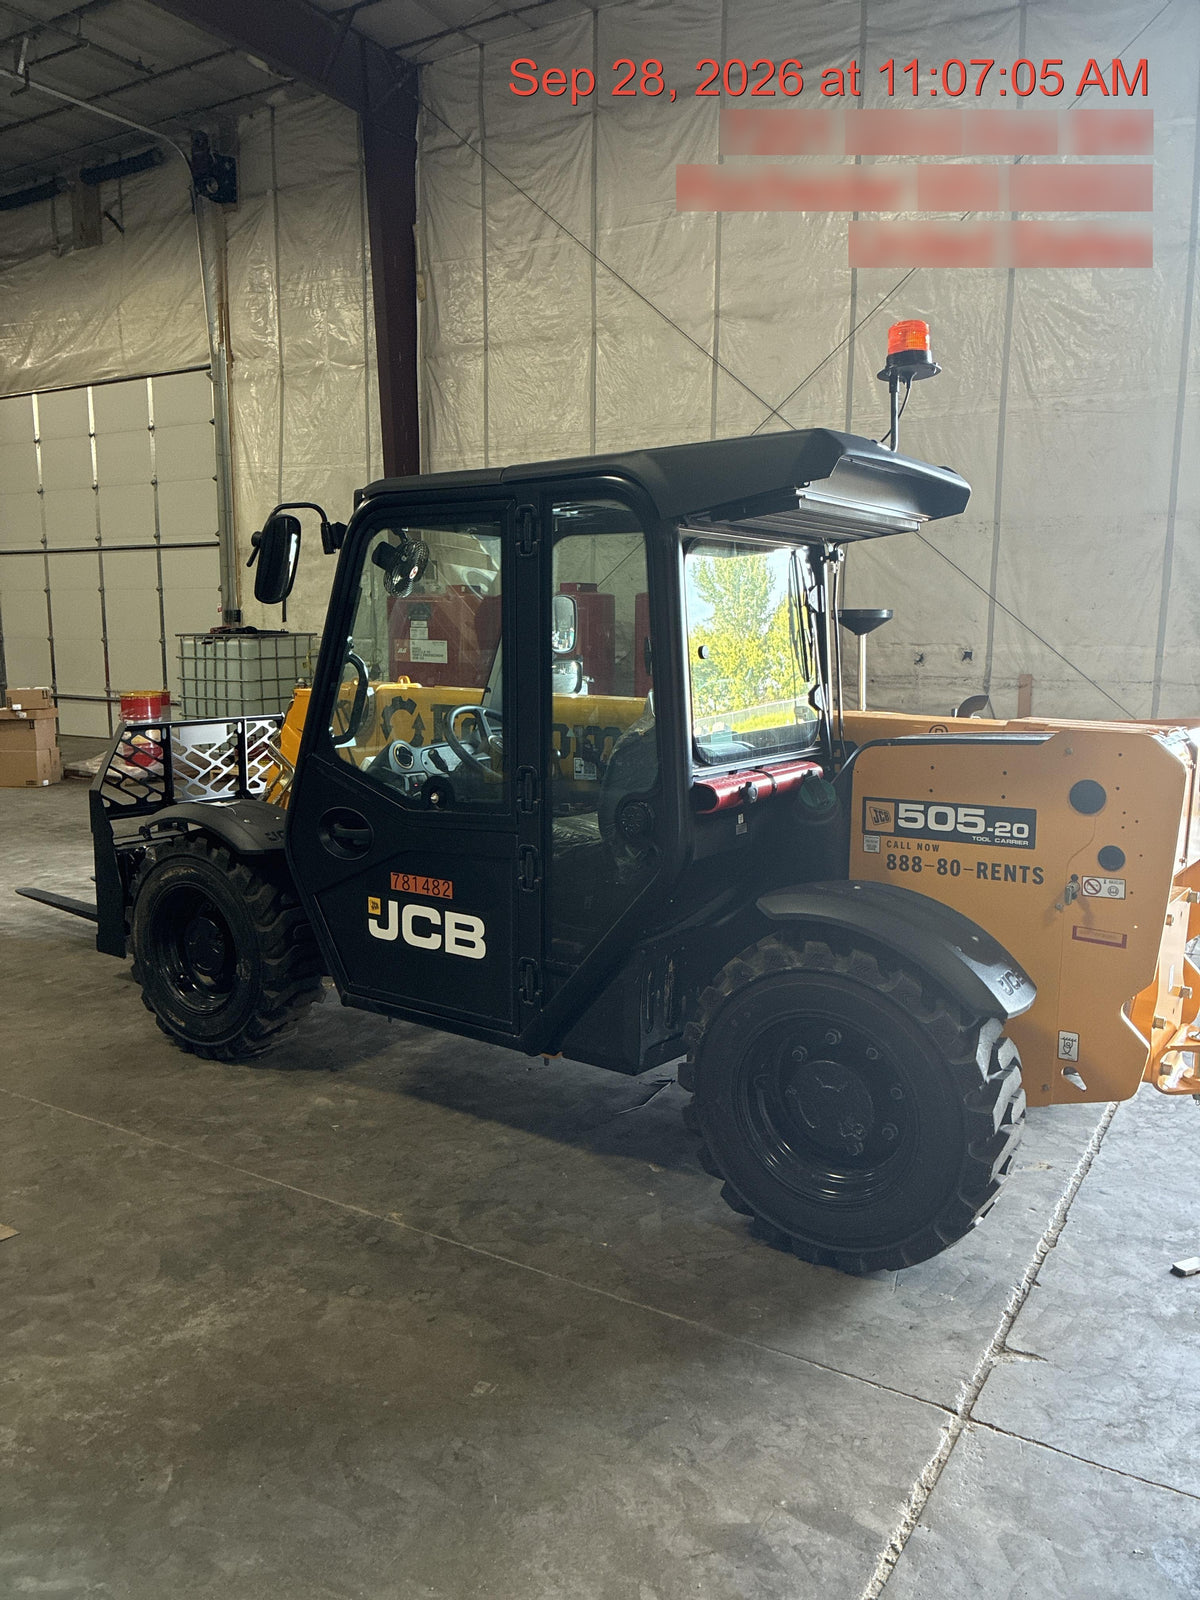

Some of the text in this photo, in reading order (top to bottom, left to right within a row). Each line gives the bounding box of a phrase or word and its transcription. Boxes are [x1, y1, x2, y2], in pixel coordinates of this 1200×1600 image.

[872, 803, 1030, 839] JCB 505-20
[886, 840, 912, 850] CALL
[916, 842, 940, 852] NOW
[972, 835, 1029, 846] TOOL CARRIER
[886, 853, 1045, 885] 888-80-RENTS
[392, 873, 451, 898] 781482
[368, 900, 487, 960] JCB
